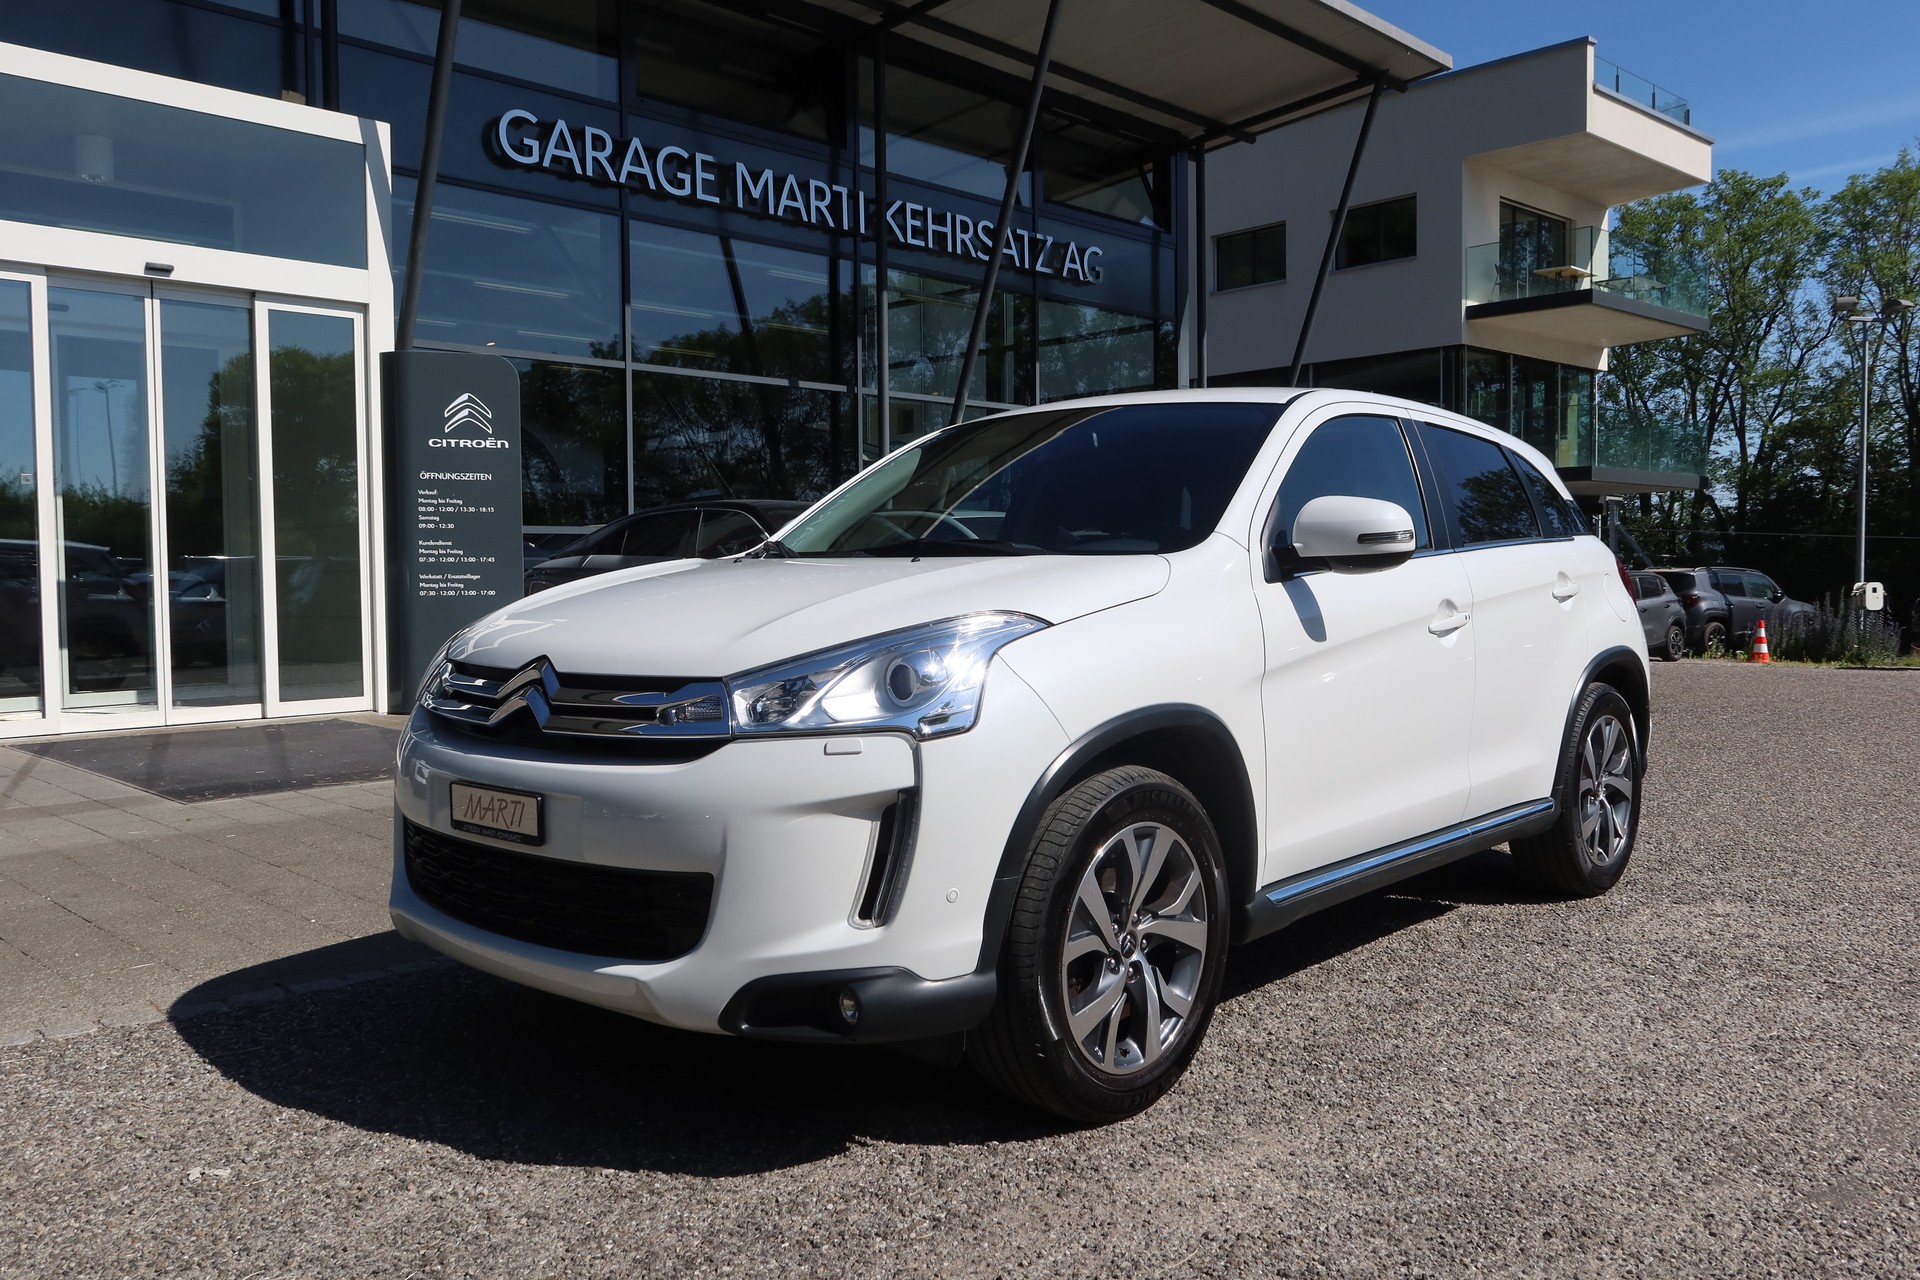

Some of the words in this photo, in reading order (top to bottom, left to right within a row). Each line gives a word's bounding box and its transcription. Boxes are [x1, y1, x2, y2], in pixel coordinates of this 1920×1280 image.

[498, 109, 720, 204] GARAGE
[735, 161, 866, 234] MARTI
[1062, 240, 1104, 284] AG
[428, 437, 509, 449] CITROËN
[419, 470, 492, 481] ÖFFNUNGSZEITEN
[464, 793, 525, 829] MARTI
